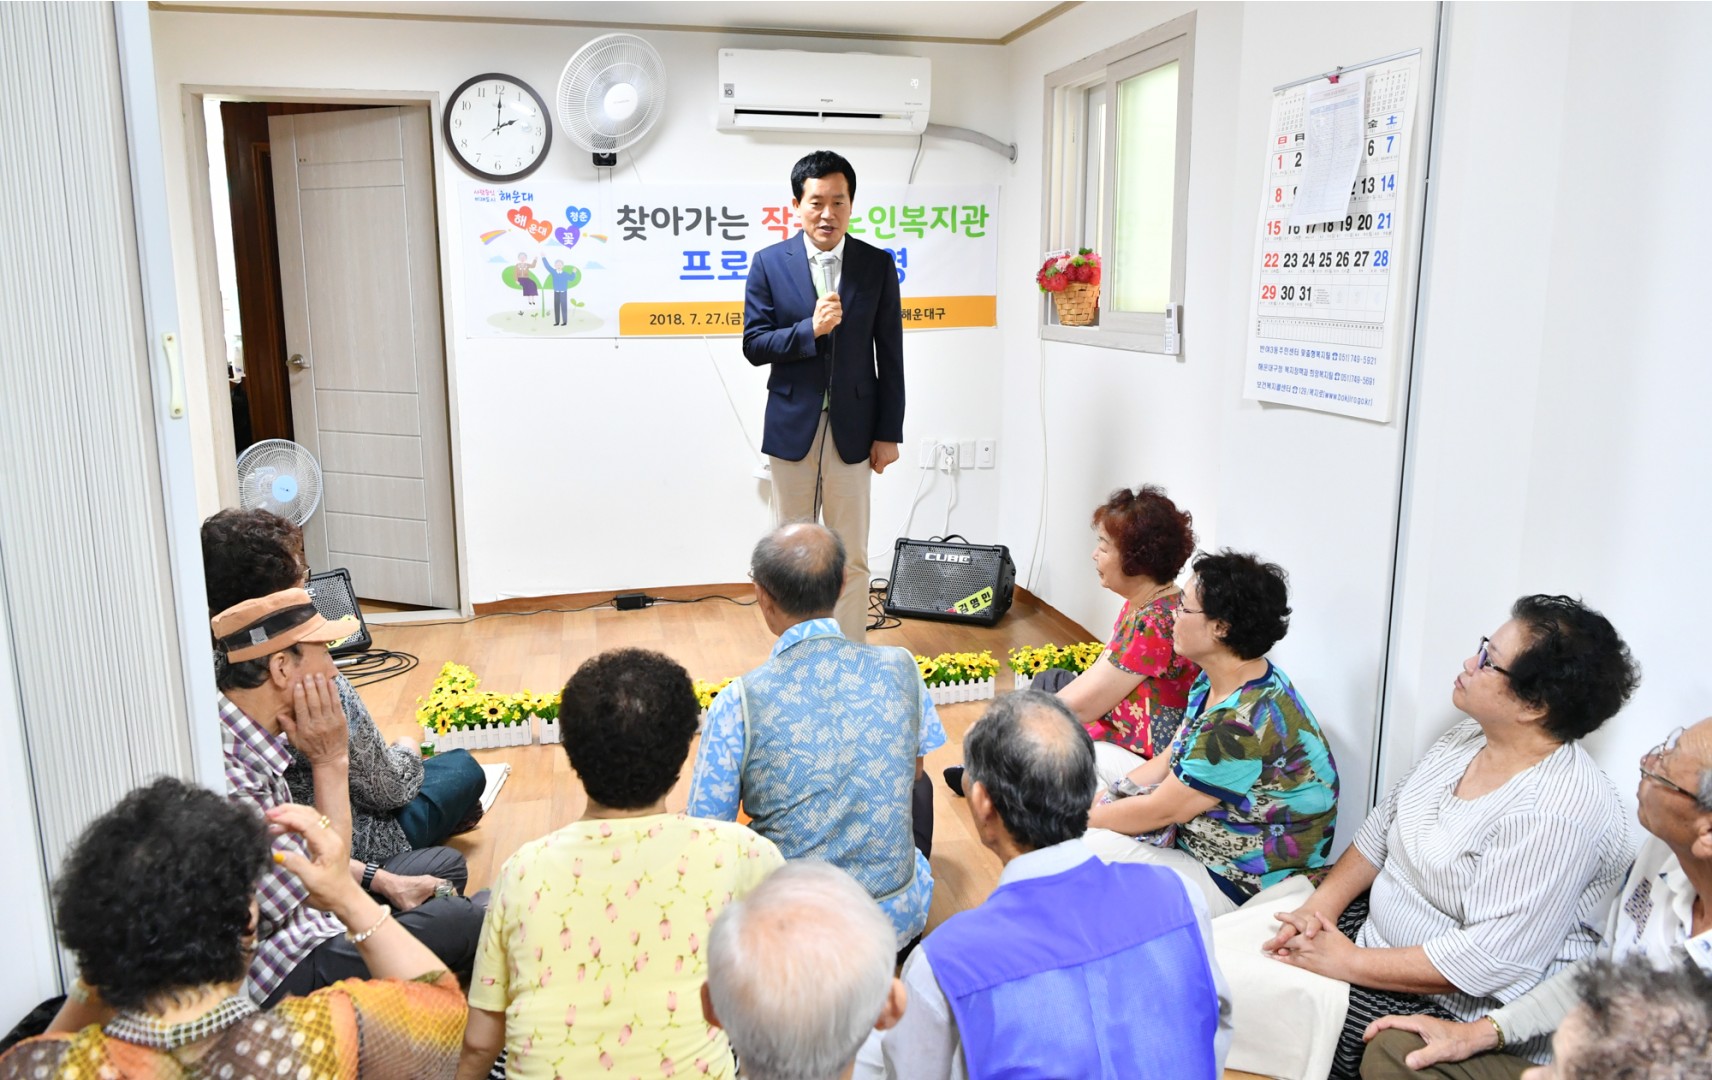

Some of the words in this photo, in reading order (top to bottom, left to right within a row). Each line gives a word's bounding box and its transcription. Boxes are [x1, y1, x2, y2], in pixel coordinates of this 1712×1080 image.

[478, 88, 485, 98] 11
[495, 85, 505, 95] 12
[462, 101, 472, 111] 10
[455, 119, 462, 129] 9
[1386, 115, 1397, 125] 土
[1278, 154, 1283, 170] 1
[1295, 152, 1302, 167] 2
[1368, 139, 1375, 156] 6
[1386, 136, 1395, 153] 7
[495, 161, 502, 170] 6
[1275, 188, 1282, 203] 8
[1361, 177, 1375, 194] 13
[1381, 174, 1395, 191] 14
[499, 190, 534, 204] 해운대
[514, 213, 527, 227] 해
[570, 211, 588, 222] 청춘
[616, 204, 749, 241] 찾아가는
[761, 206, 803, 240] 작
[529, 224, 547, 236] 운대
[1267, 221, 1281, 235] 15
[1357, 214, 1373, 231] 20
[1377, 213, 1392, 230] 21
[562, 232, 574, 245] 꽃
[1264, 253, 1279, 267] 22
[1283, 253, 1298, 268] 23
[1302, 253, 1315, 268] 24
[1319, 252, 1332, 268] 25
[1336, 252, 1349, 267] 26
[1354, 251, 1369, 267] 27
[1373, 250, 1389, 267] 28
[1261, 285, 1277, 300] 29
[1281, 286, 1295, 301] 30
[1299, 286, 1311, 301] 31
[649, 313, 685, 326] 2018.
[690, 313, 701, 325] 7.
[901, 307, 946, 321] 해운대구
[924, 552, 971, 564] CUBE
